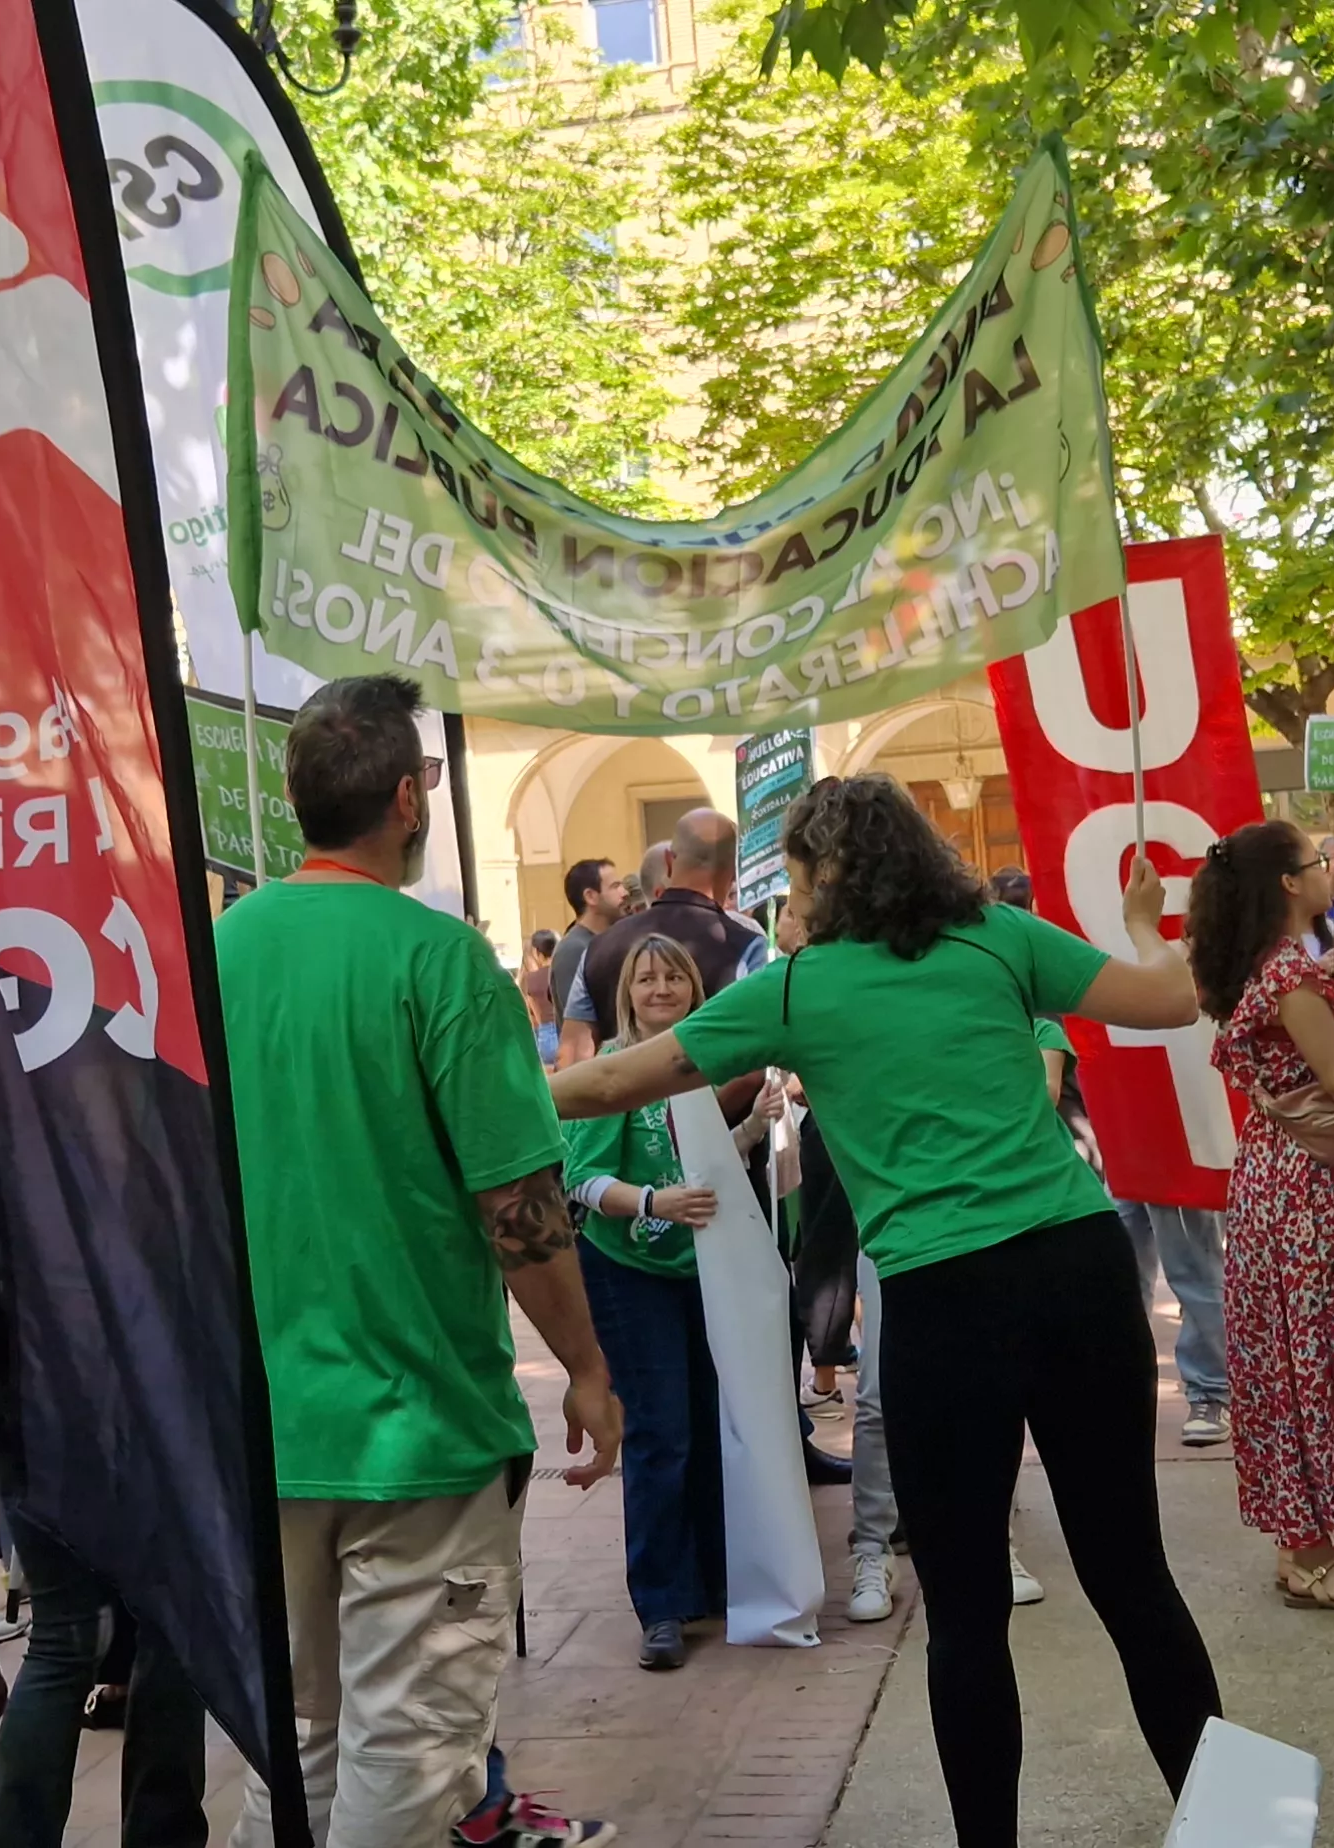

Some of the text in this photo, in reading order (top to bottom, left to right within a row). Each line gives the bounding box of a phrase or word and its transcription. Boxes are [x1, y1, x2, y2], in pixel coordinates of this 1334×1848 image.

[748, 729, 792, 763] HUELGA
[741, 744, 805, 790] EDUCATIVA
[218, 785, 246, 810] DE
